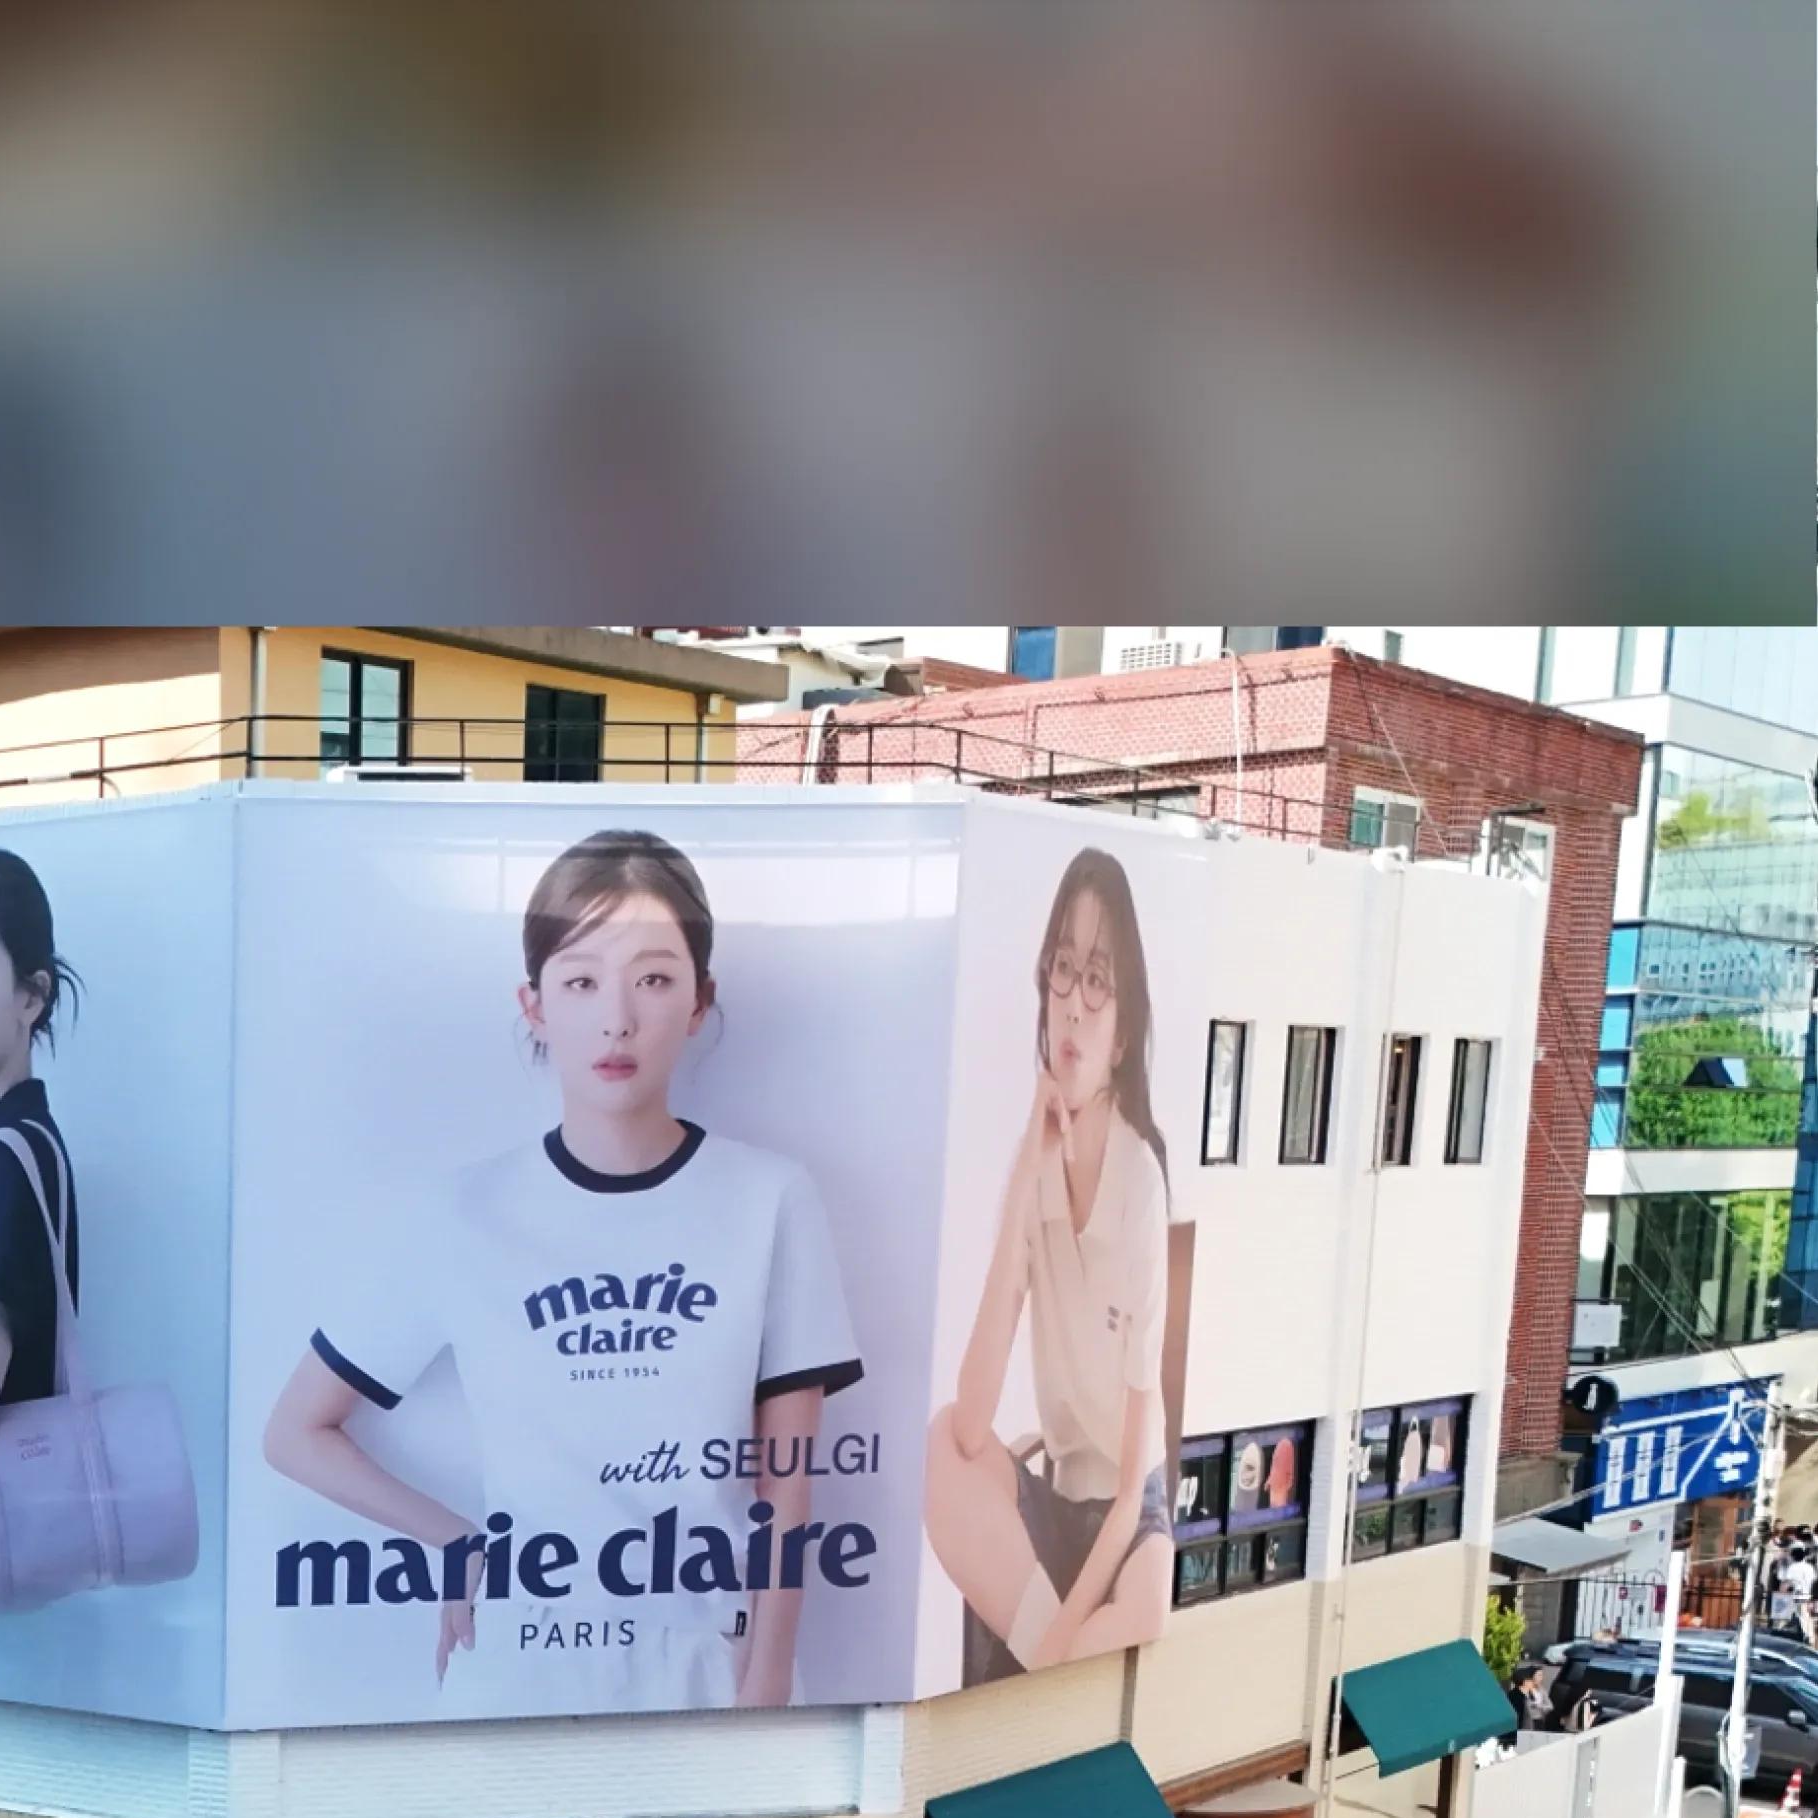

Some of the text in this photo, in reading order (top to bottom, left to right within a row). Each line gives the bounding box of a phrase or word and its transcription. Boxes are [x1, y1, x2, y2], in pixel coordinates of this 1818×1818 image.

[523, 1262, 719, 1331] marie
[556, 1317, 678, 1356] claire
[568, 1366, 662, 1382] SINCE 1954
[599, 1433, 882, 1486] with SEULGI
[274, 1500, 879, 1609] marie claire
[519, 1619, 638, 1650] PARIS
